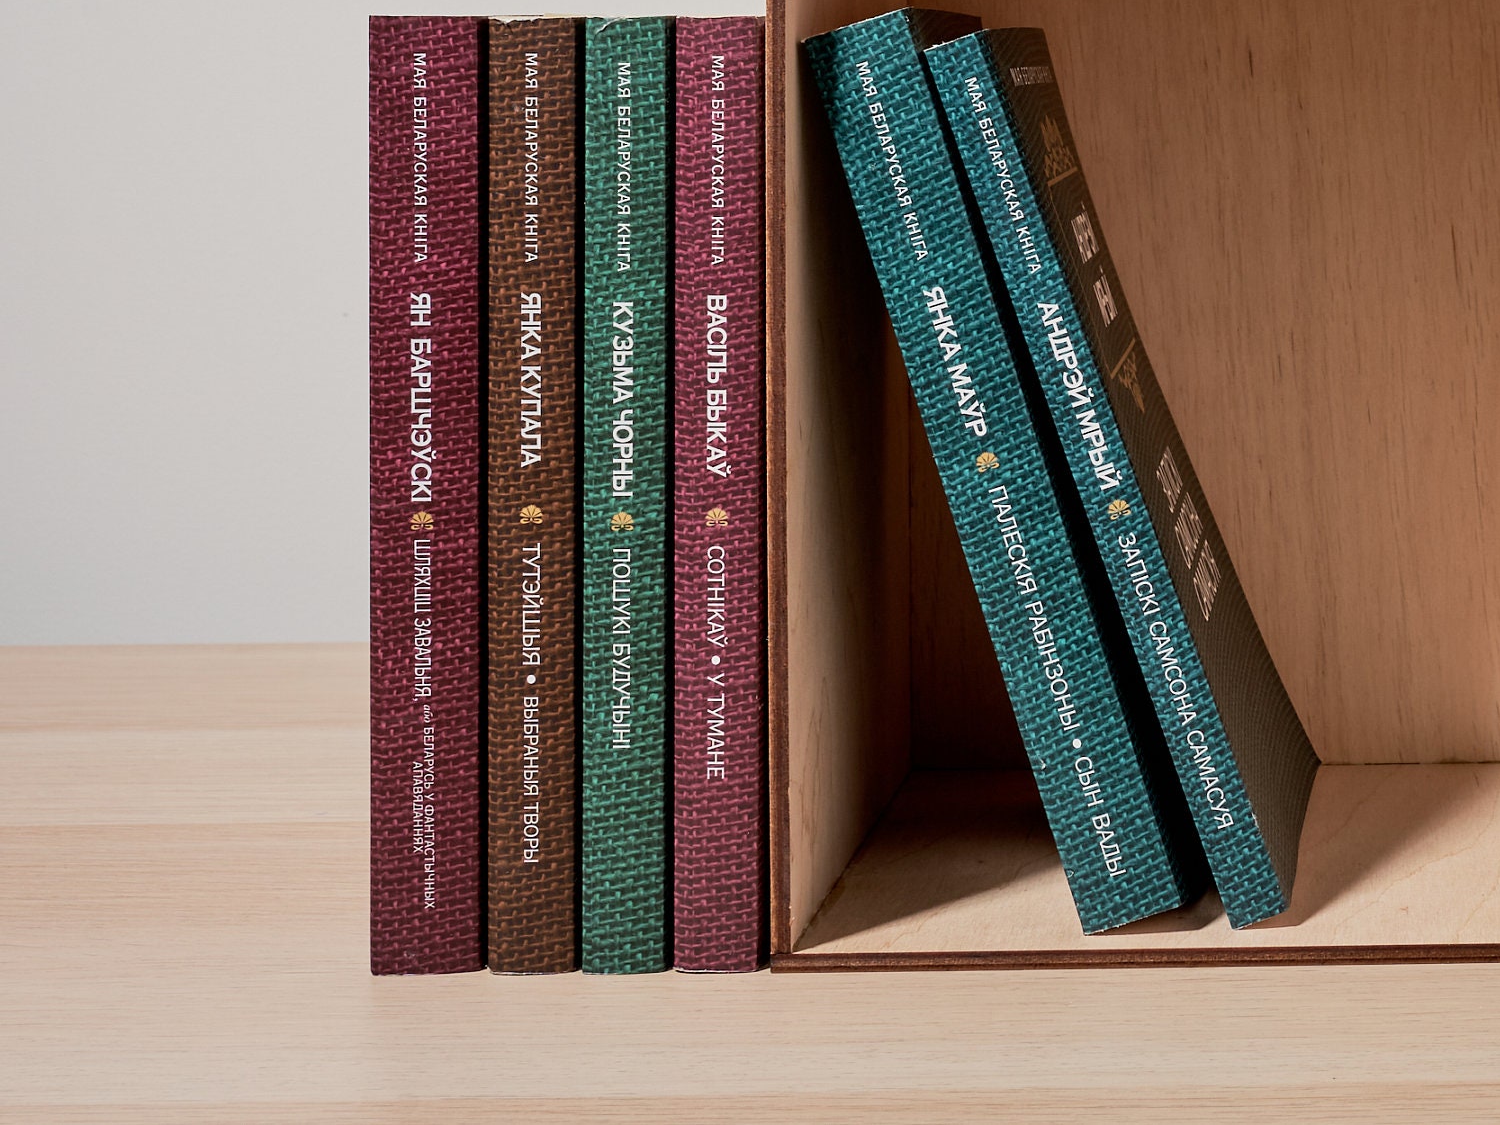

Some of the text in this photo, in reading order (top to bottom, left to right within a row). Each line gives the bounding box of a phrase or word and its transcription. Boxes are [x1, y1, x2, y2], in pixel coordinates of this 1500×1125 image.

[409, 52, 437, 909] МАЯ БЕЛАРУСКАЯ КНІГА ЯН БАРШЧЭЎСКІ ШЛЯХЦІЦ ЗАВАЛЬНЯ, або БЕЛАРУСЬ У ФАНТАСТЫЧНЫХ
[520, 52, 544, 863] МАЯ БЕЛАРУСКАЯ КНІГА ЯНКА КУПАЛА ТУТЭЙШЫЯ ВЫБРАНЫЯ ТВОРЫ
[611, 62, 634, 749] МАЯ БЕЛАРУСКАЯ КНІГА КУЗЬМА ЧОРНЫ ПОШУКІ БУДУЧЫНІ
[705, 55, 732, 780] МАЯ БЕЛАРУСКАЯ КНІГА ВАСІЛЬ БЫКАЎ СОТНІКАЎ У ТУМАНЕ
[855, 60, 1127, 878] МАЯ БЕЛАРУСКАЯ КНІГА ЯНКА МАЎР ПАЛЕСКІЯ РАБІНЗОНЫ СЫН ВАДЫ
[964, 76, 1234, 830] МАЯ БЕЛАРУСКАЯ КНІГА АНДРЭЙ МРЫЙ ЗАПІСКІ САМСОНА САМАСУЯ
[412, 761, 424, 853] АПАВЯДАННЯХ
